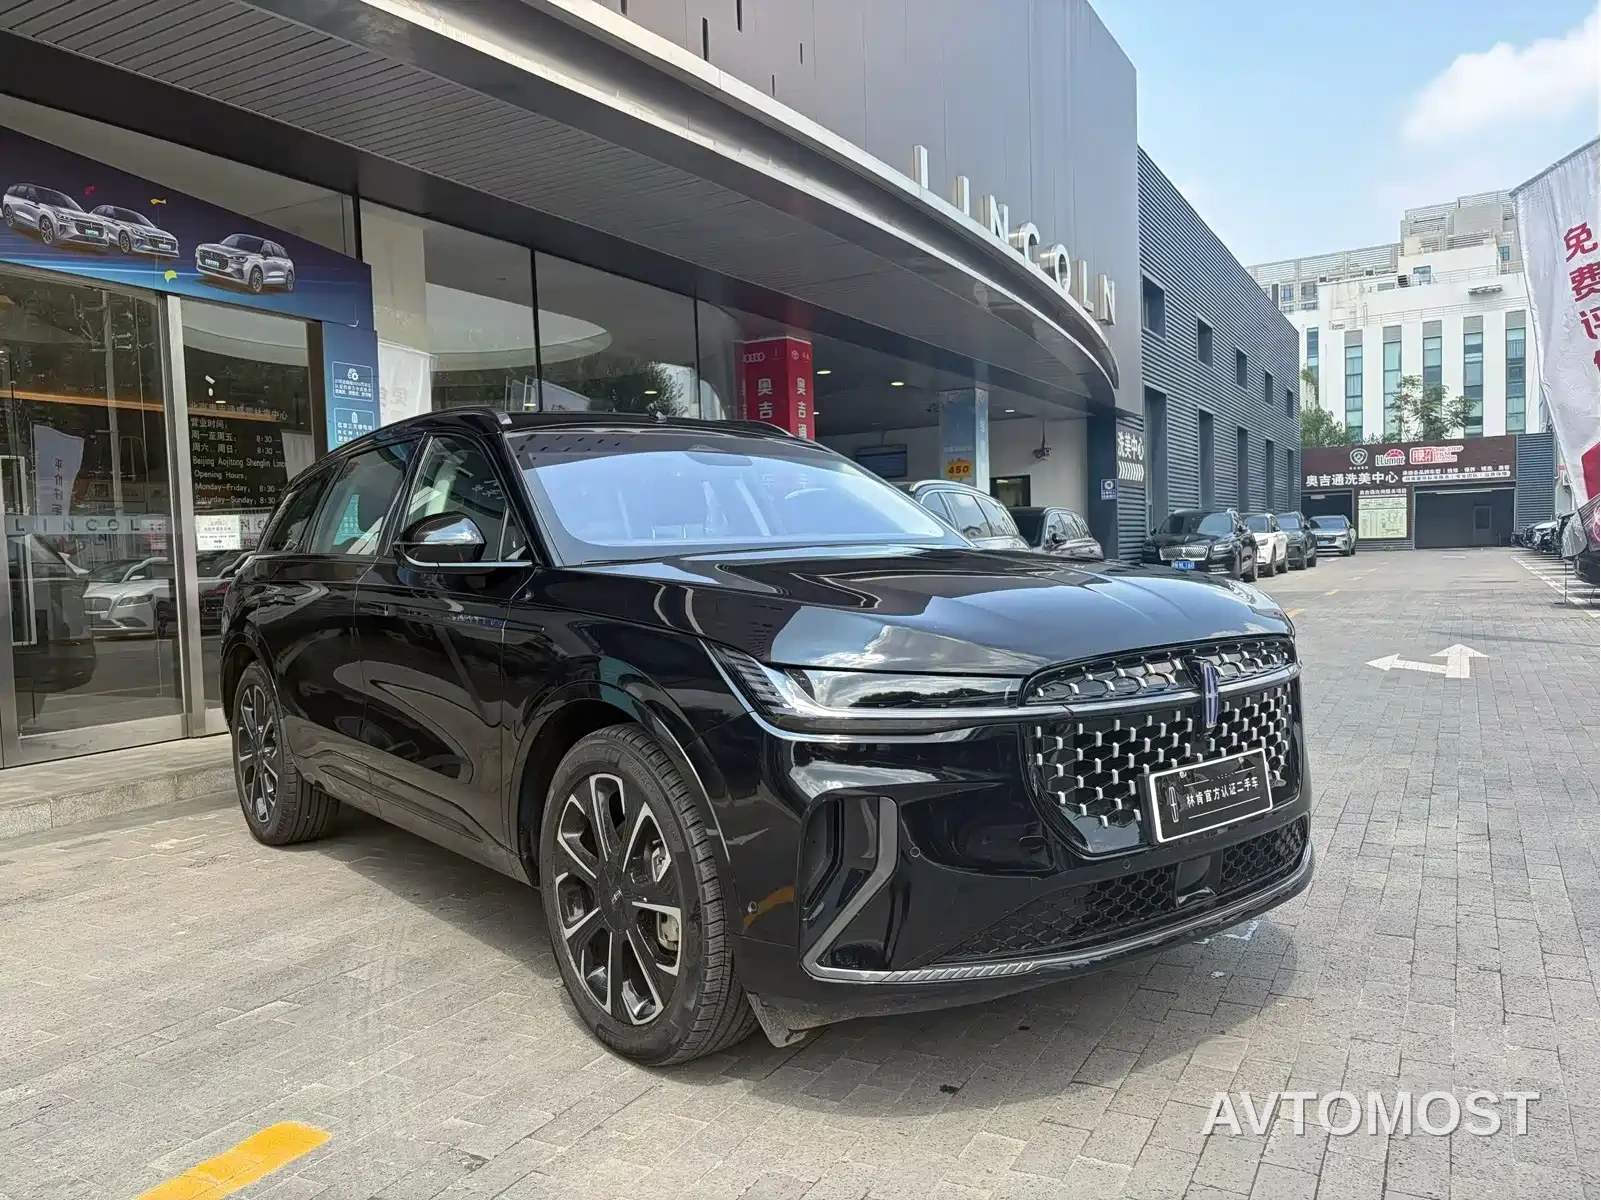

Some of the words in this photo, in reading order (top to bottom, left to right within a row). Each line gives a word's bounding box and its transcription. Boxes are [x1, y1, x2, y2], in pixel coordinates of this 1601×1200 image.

[257, 447, 273, 455] 8:30
[1117, 431, 1145, 460] 洗美中心
[192, 456, 215, 467] Beijing
[194, 470, 222, 479] Opening
[948, 465, 969, 474] 450
[1306, 471, 1398, 487] 奥吉通洗美中心
[1186, 776, 1259, 808] 林肯官方认证二手车
